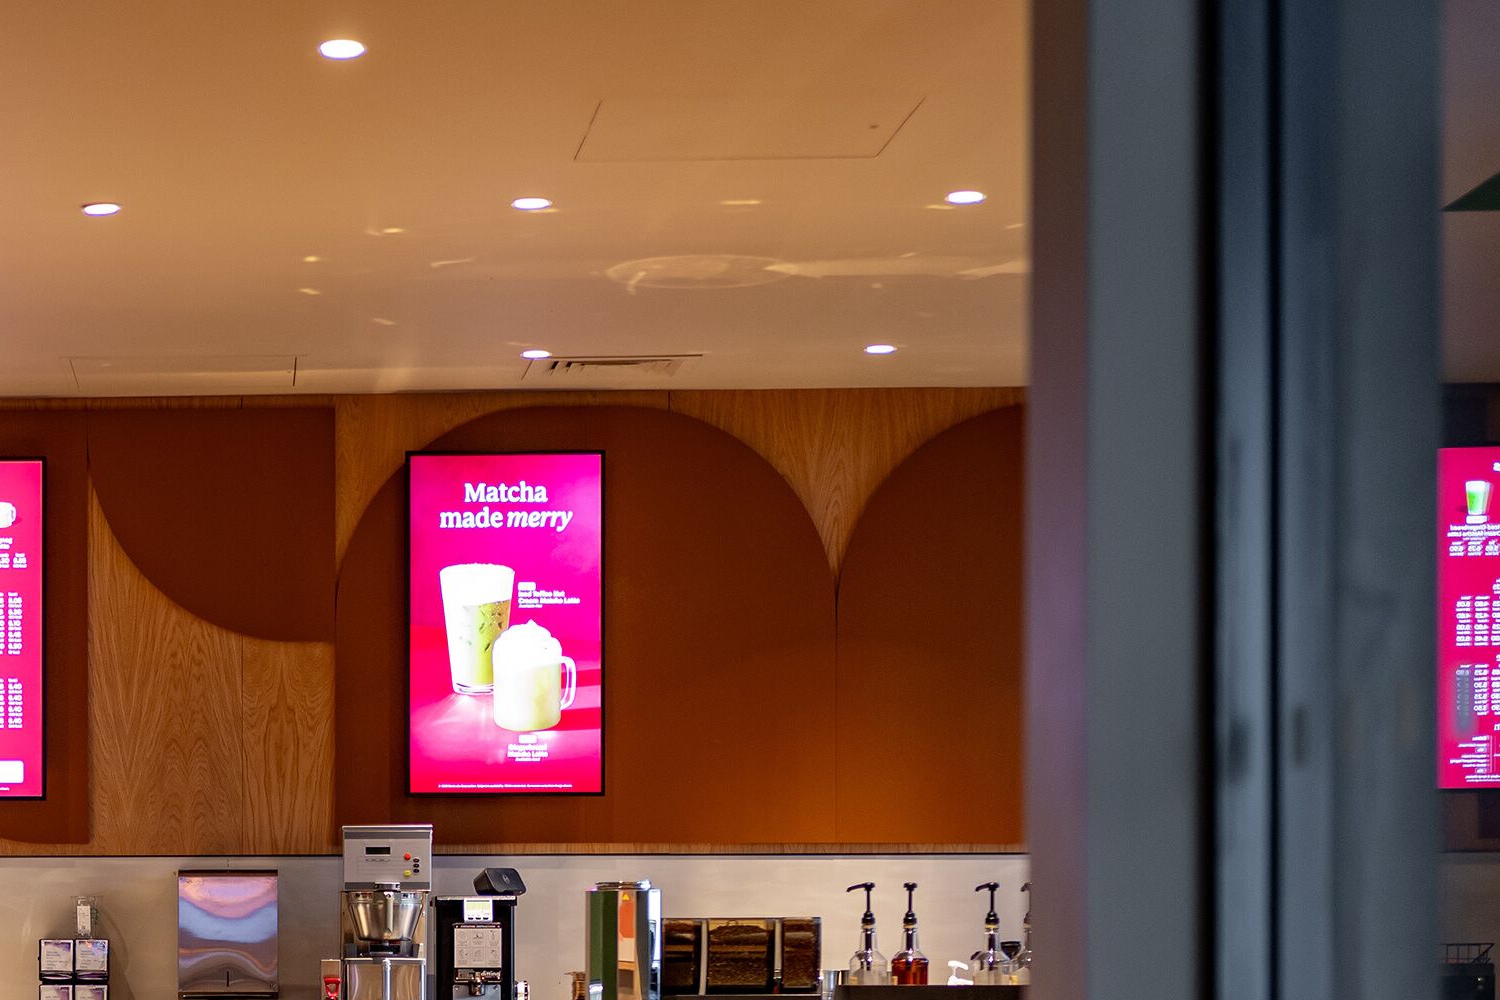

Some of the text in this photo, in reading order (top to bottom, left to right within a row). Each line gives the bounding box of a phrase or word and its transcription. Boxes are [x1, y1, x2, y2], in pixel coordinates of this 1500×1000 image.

[465, 481, 548, 502] Matcha
[440, 507, 573, 531] made merry
